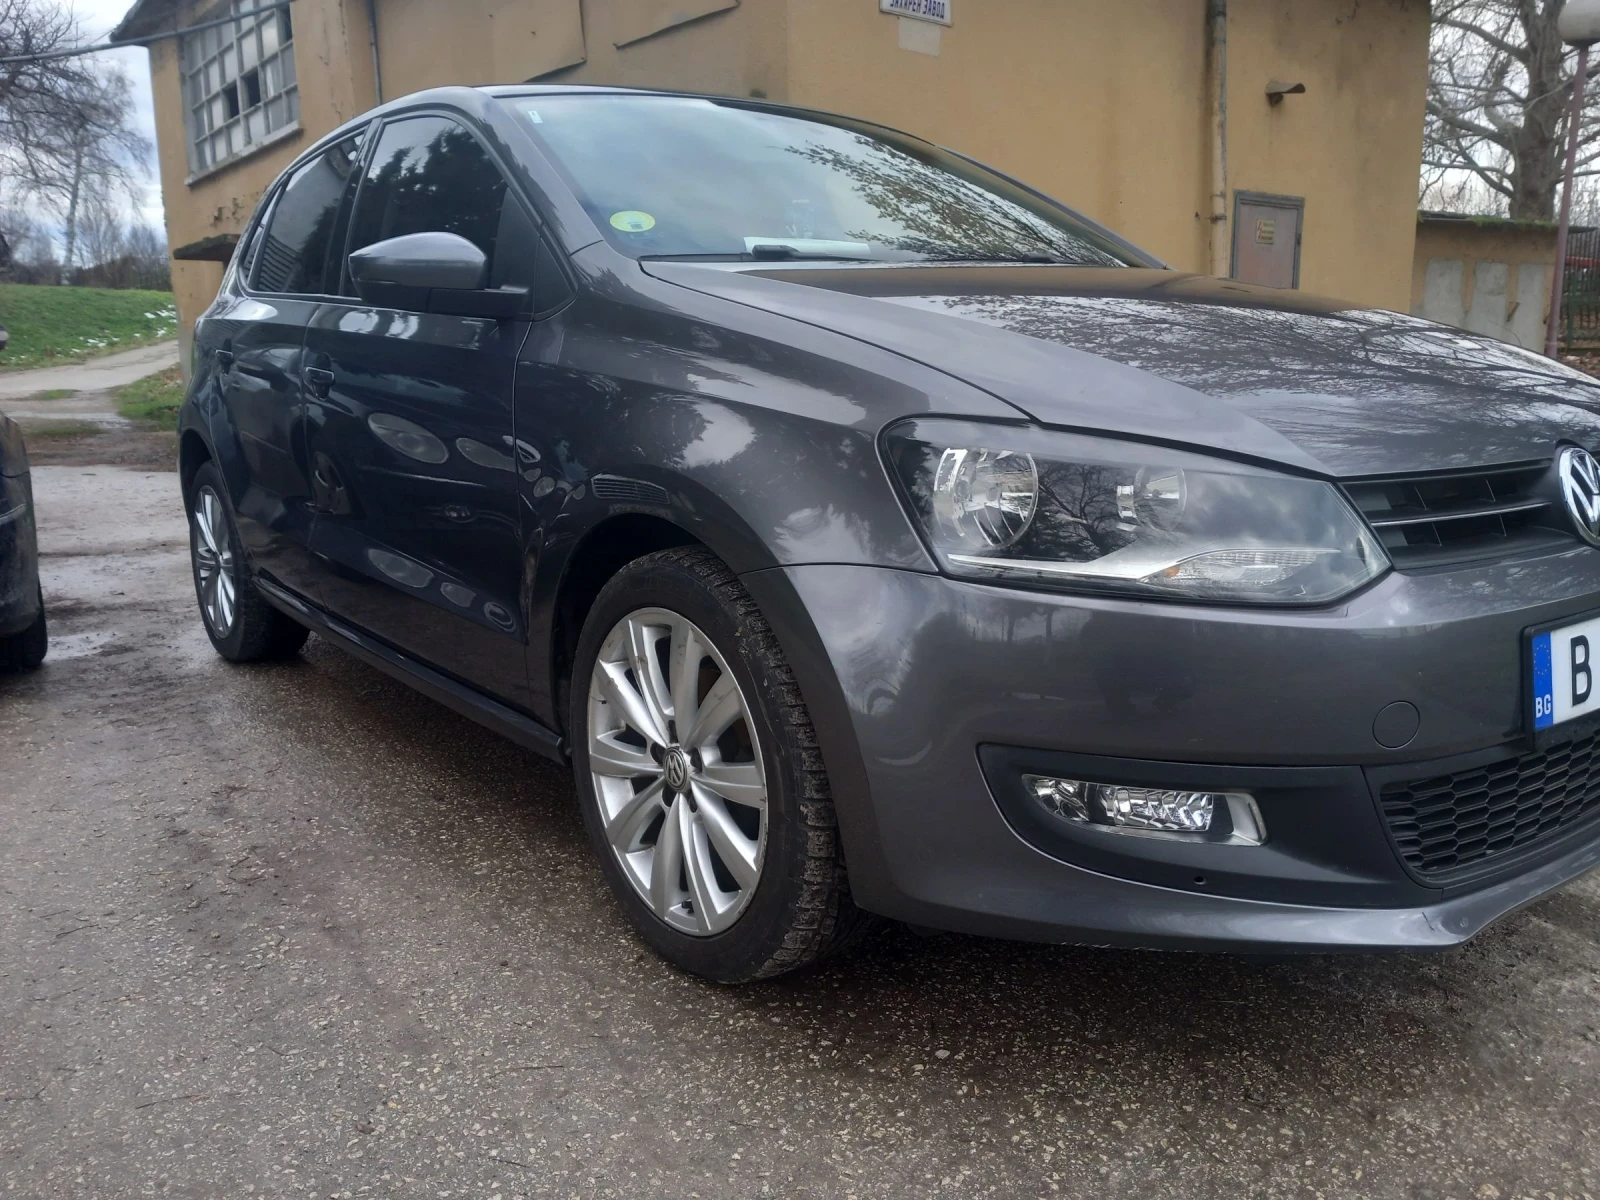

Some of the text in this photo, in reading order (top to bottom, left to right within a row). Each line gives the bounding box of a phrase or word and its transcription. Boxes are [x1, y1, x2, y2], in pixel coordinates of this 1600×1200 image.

[922, 0, 945, 19] ЗАВОД
[1570, 635, 1592, 707] B
[1535, 694, 1551, 718] BG
